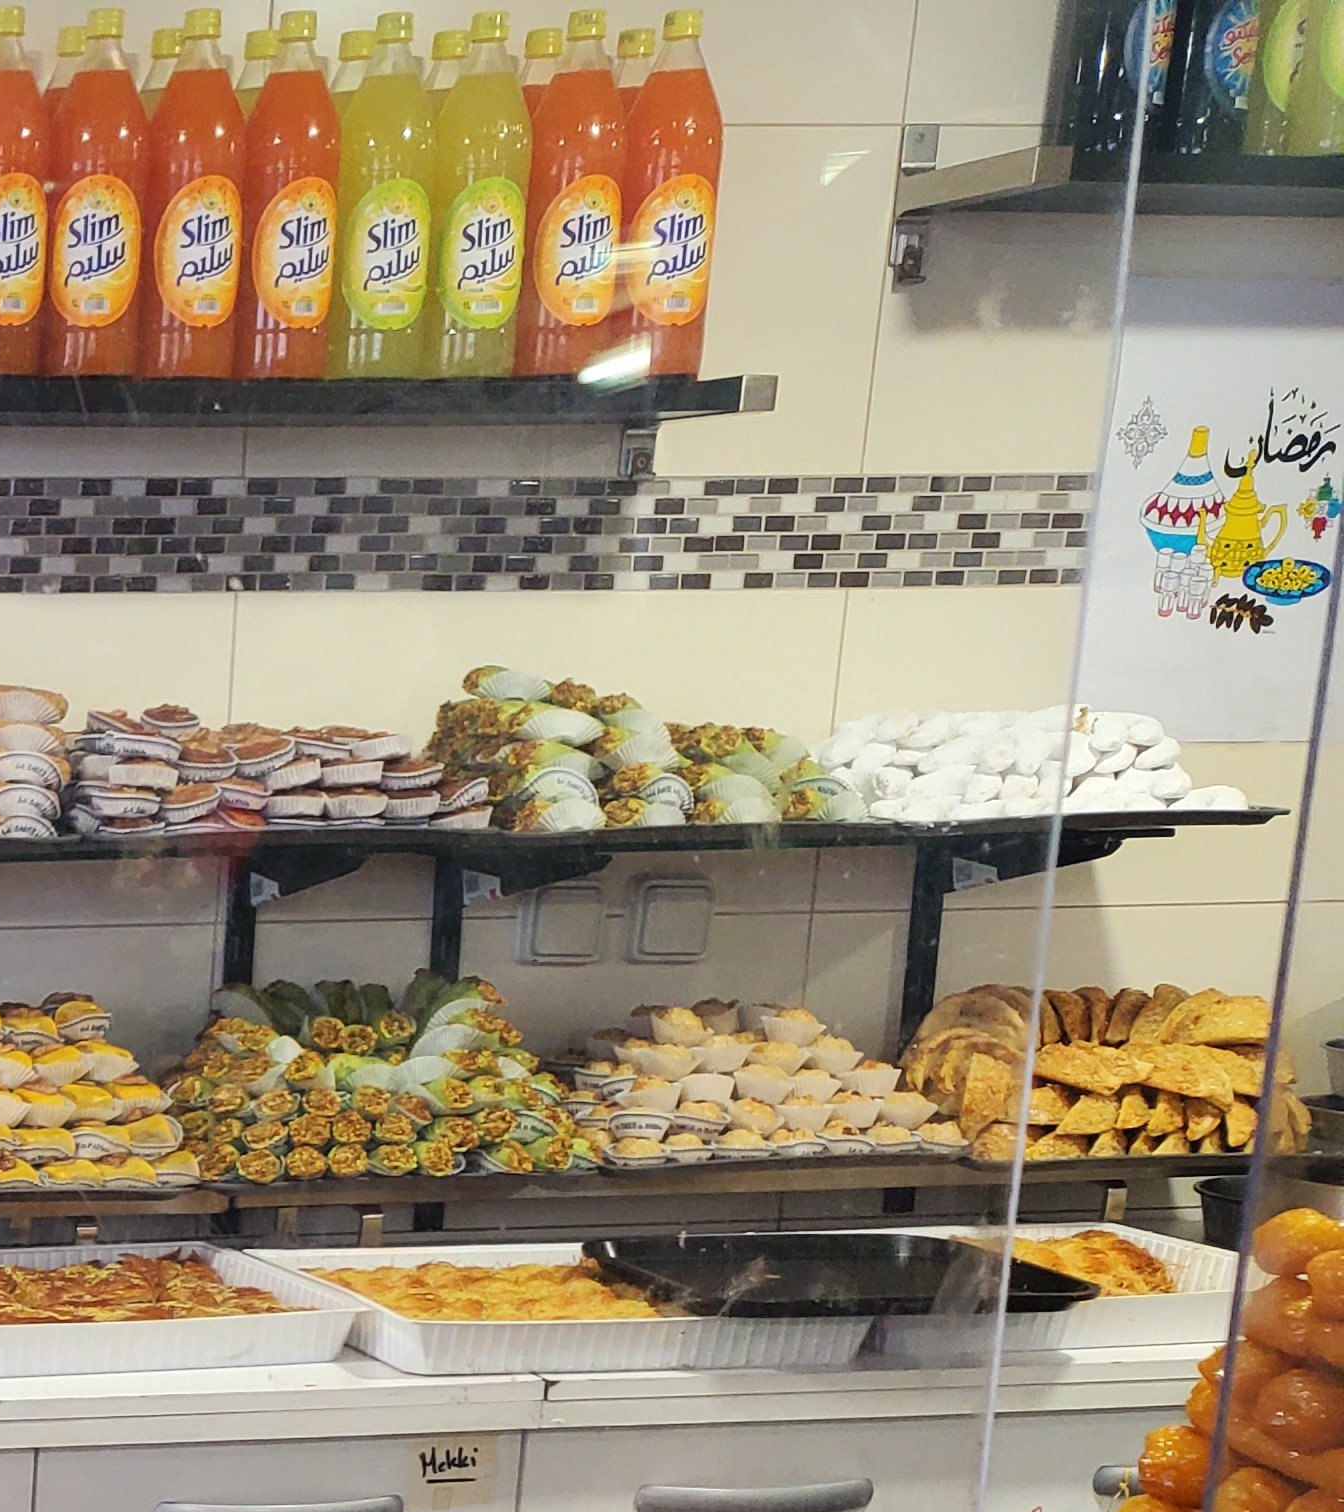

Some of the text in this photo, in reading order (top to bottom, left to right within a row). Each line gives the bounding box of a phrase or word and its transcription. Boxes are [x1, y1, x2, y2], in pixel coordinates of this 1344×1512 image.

[68, 213, 120, 249] Slim
[180, 214, 230, 249] Slim
[279, 215, 328, 249] Slim
[366, 218, 418, 253] Slim
[461, 217, 511, 252] Slim
[560, 214, 611, 248] Slim
[653, 213, 704, 248] Slim
[64, 242, 126, 287] سليم
[177, 243, 233, 287] سليم
[274, 246, 329, 288] سليم
[364, 246, 420, 291] سليم
[458, 245, 515, 290] سليم
[646, 241, 707, 285] سليم
[419, 1447, 479, 1478] Mekki
